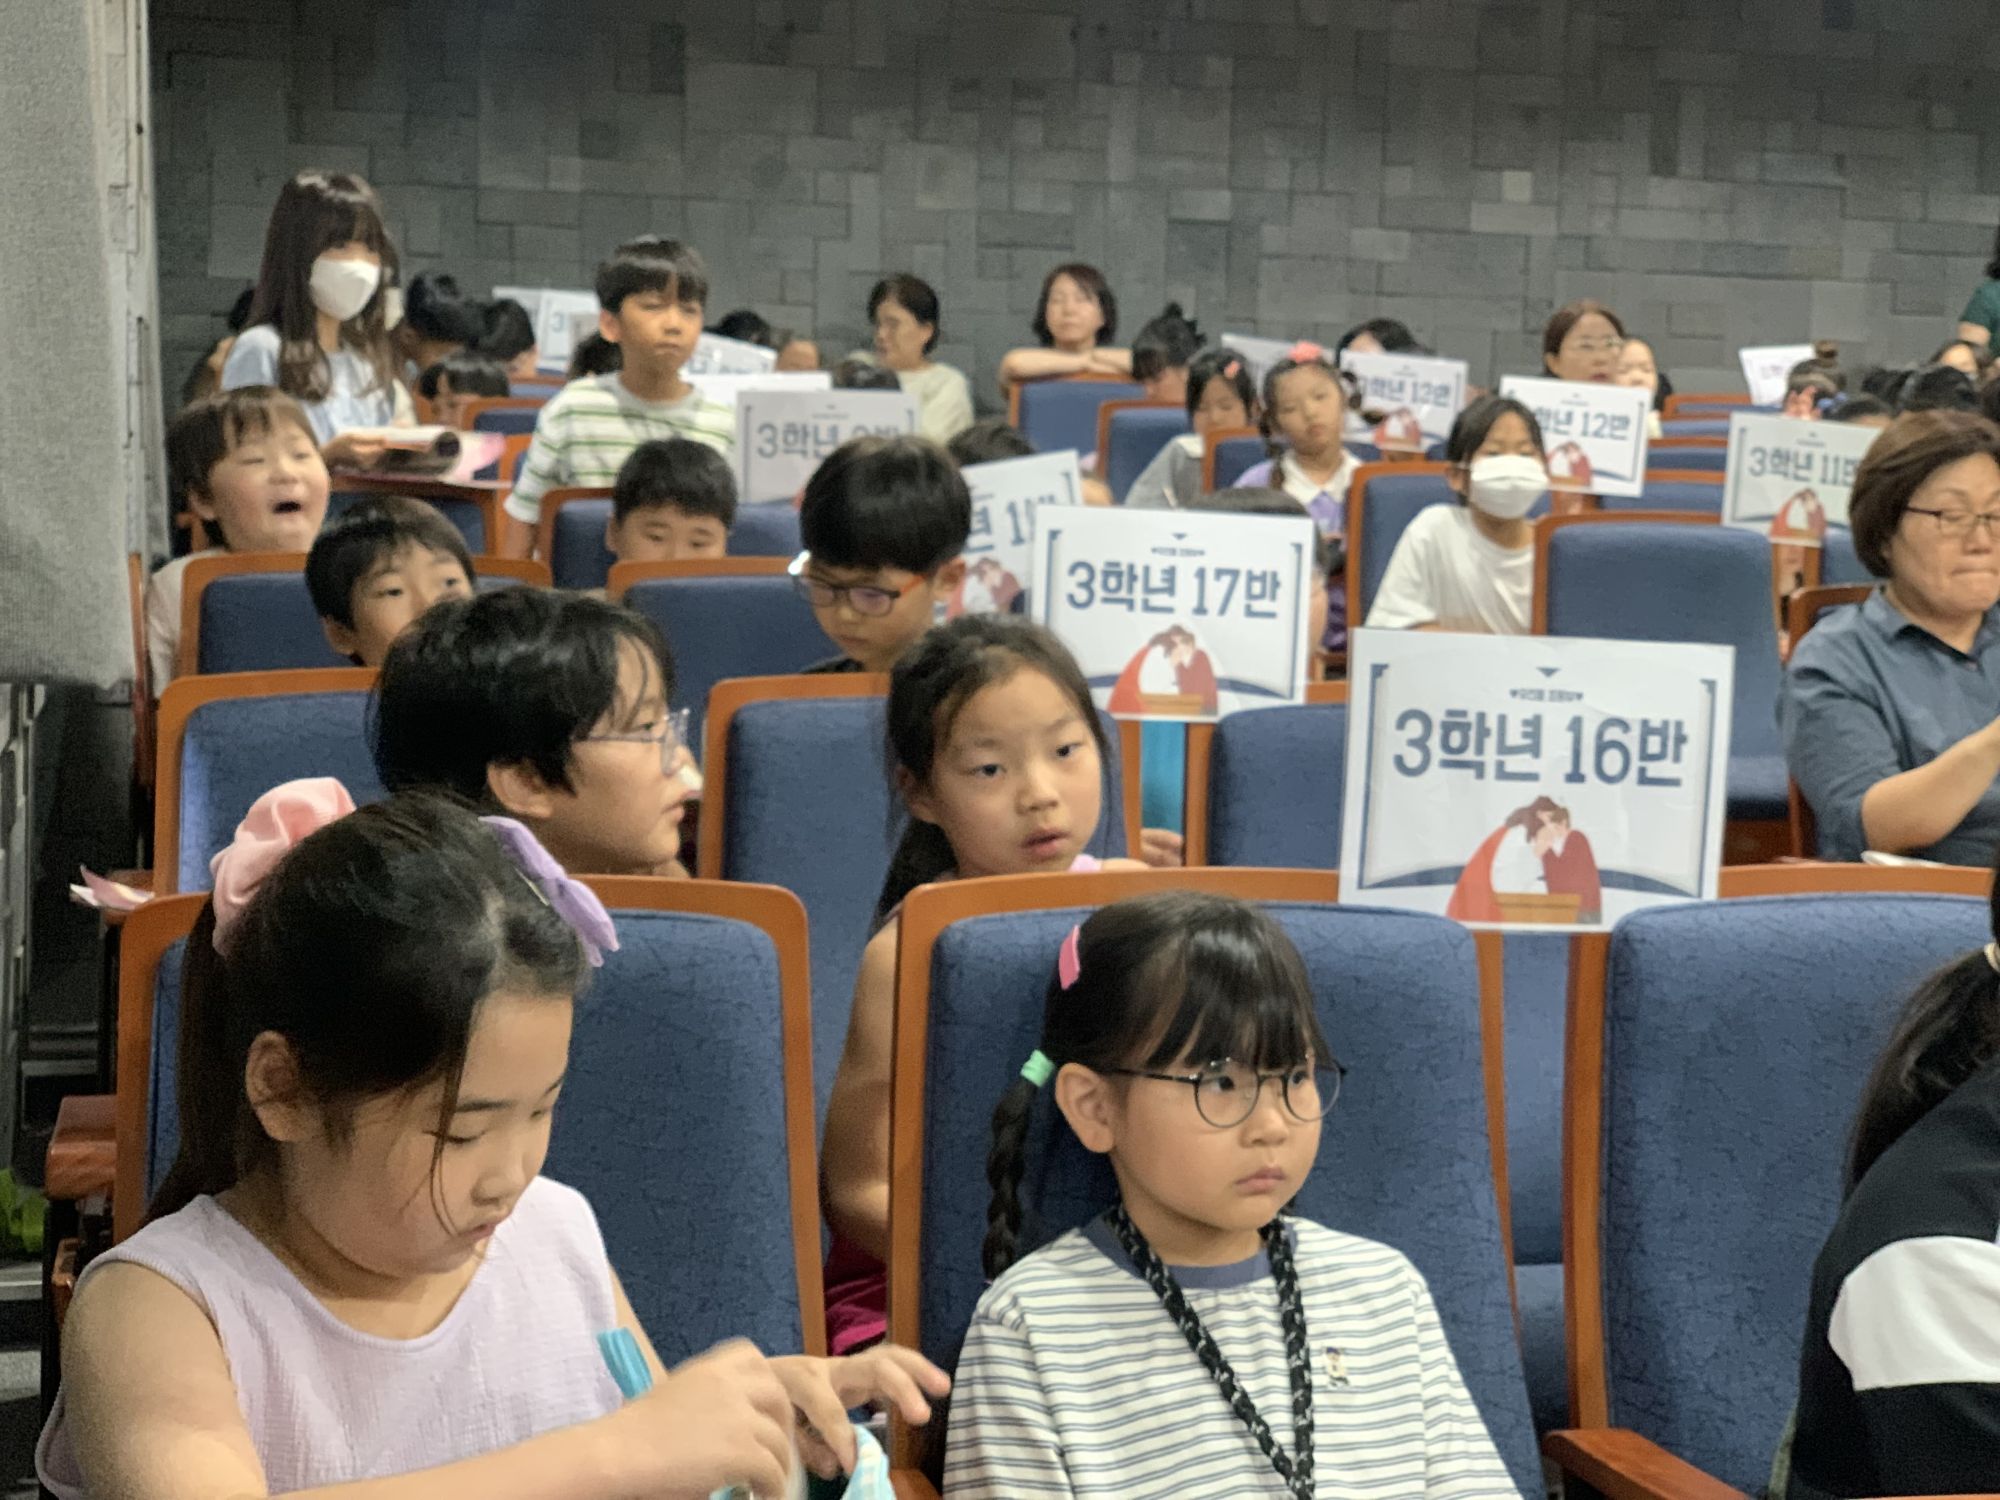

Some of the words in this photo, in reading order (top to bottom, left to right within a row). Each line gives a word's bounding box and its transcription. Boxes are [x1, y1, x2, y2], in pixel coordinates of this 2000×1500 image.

[1581, 412, 1631, 441] 12반
[1749, 446, 1813, 482] 3학년
[1066, 561, 1176, 613] 3학년
[1192, 566, 1281, 619] 17반
[1393, 709, 1543, 781] 3학년
[1564, 715, 1689, 788] 16반
